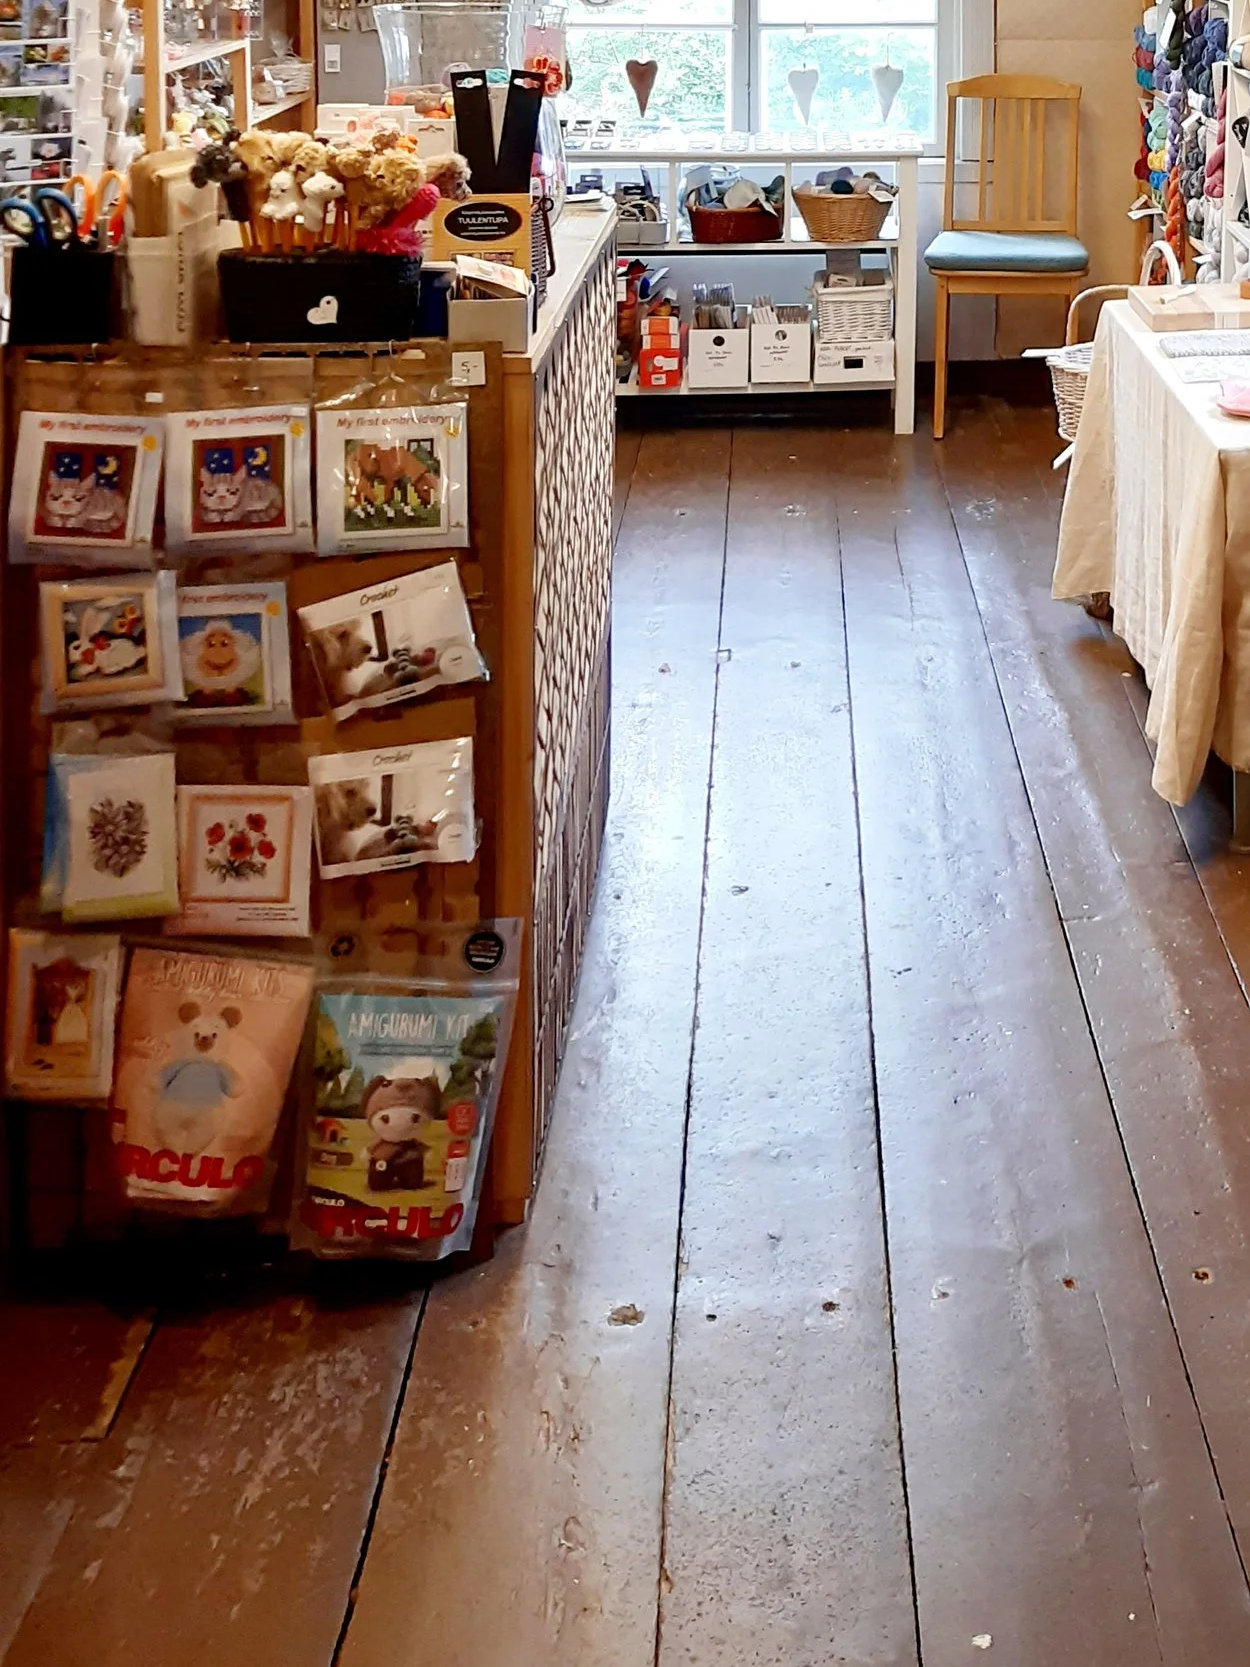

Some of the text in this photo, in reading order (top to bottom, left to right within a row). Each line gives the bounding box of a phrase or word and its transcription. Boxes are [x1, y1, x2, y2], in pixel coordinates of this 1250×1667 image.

[457, 216, 509, 224] TUULENTUPA
[336, 417, 352, 430] My
[356, 415, 379, 427] first
[347, 1011, 438, 1040] AMIGURUMI
